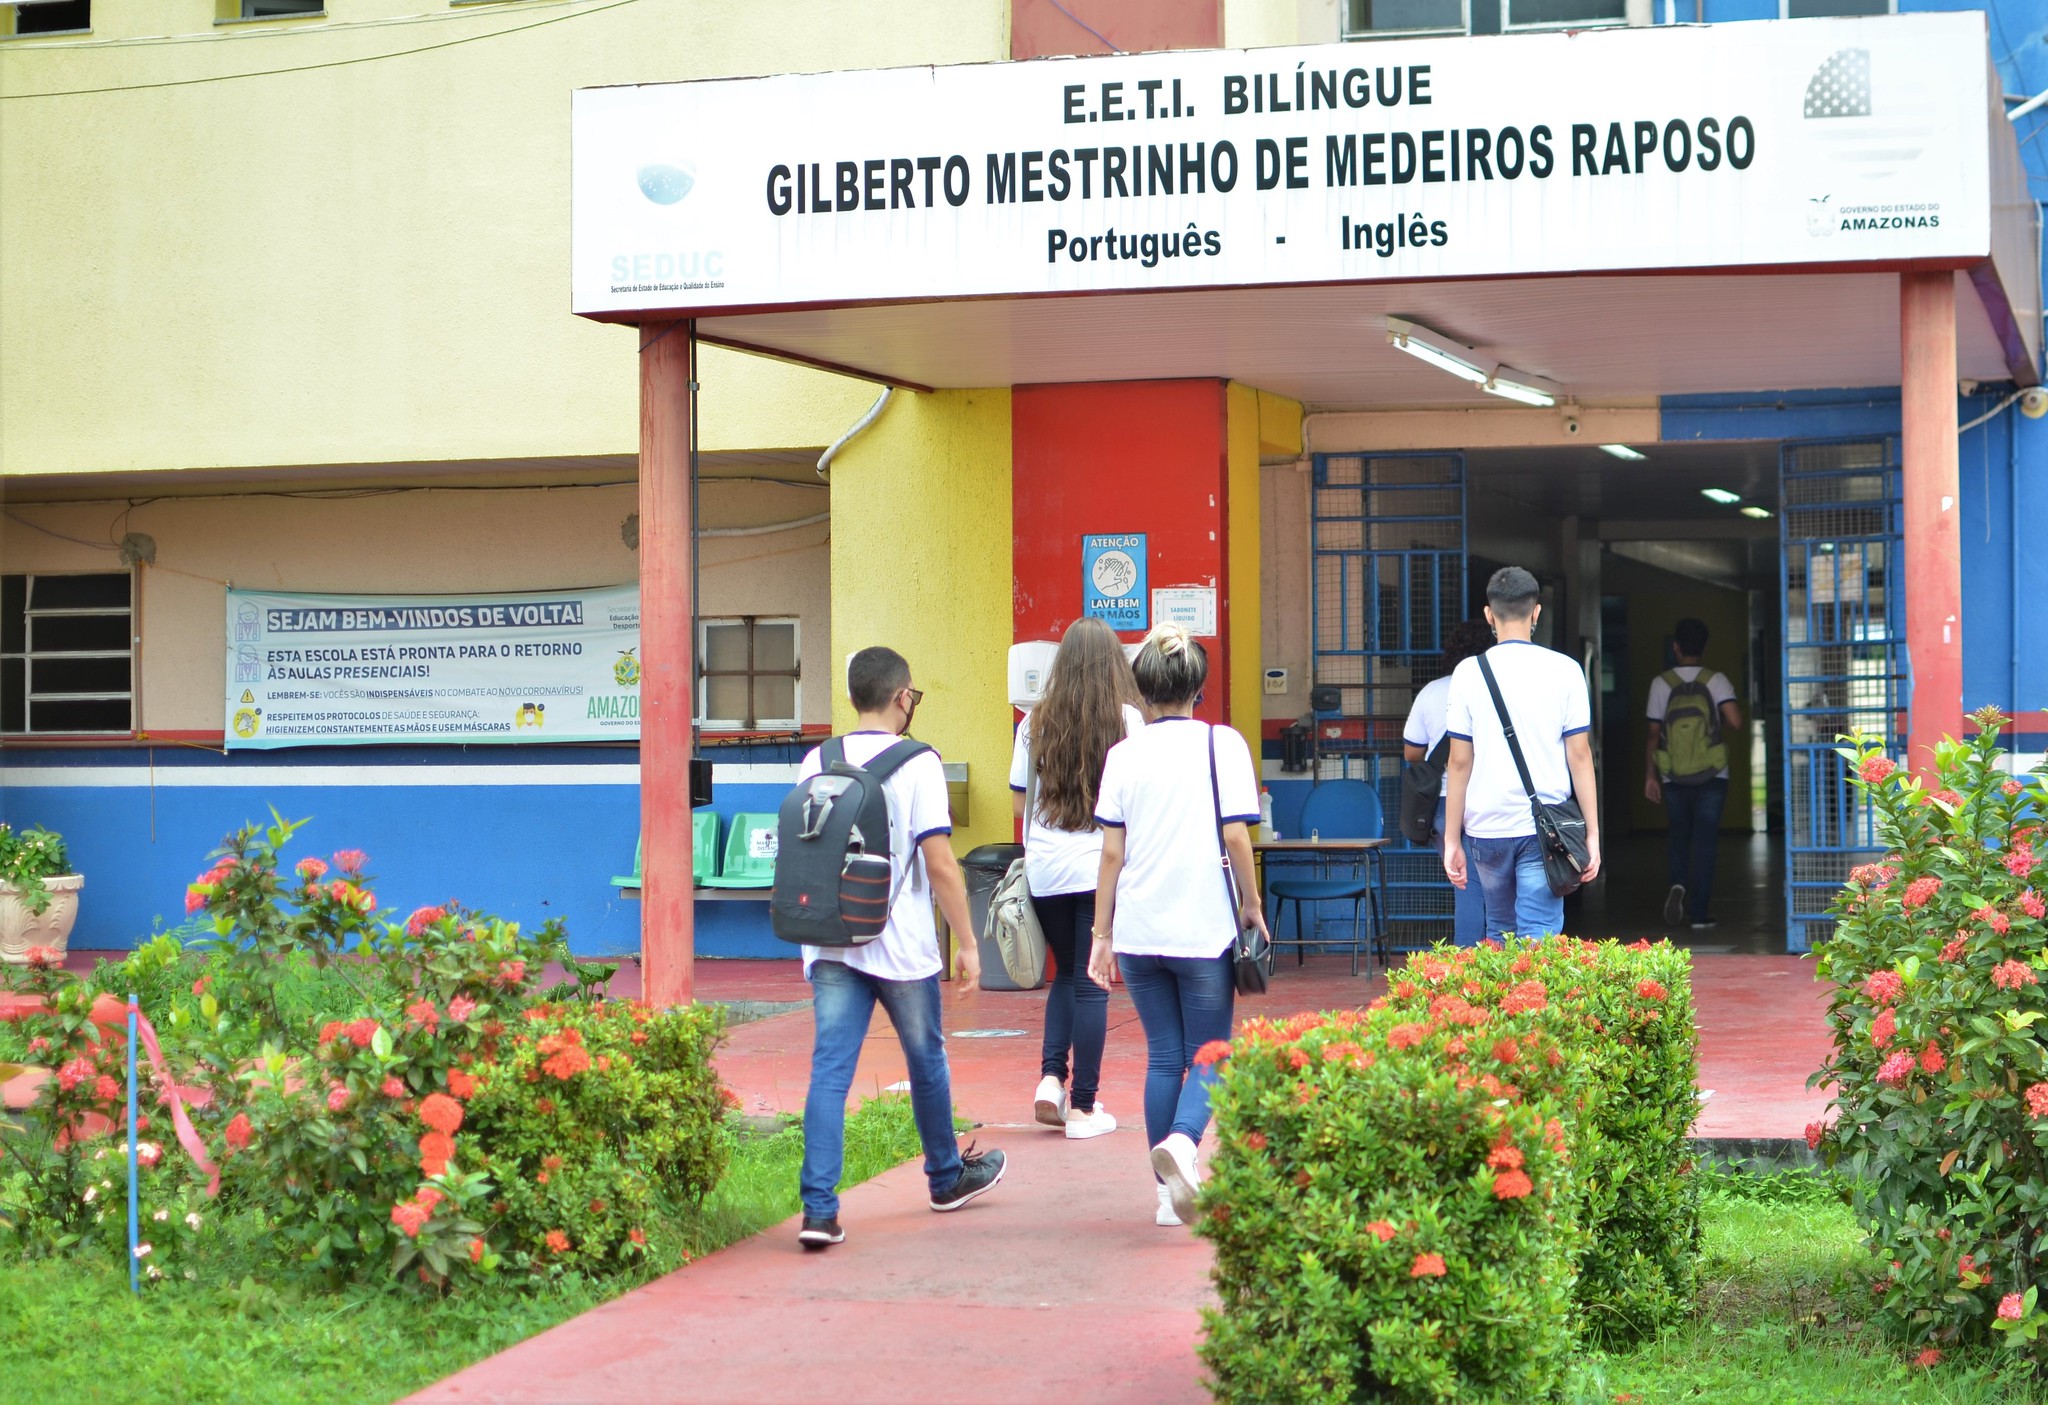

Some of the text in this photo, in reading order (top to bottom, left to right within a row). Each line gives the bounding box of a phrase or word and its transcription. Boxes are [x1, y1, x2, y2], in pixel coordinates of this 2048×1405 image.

[1064, 62, 1431, 123] E.E.T.I. BILÍNGUE
[767, 116, 1754, 215] GILBERTO MESTRINHO DE MEDEIROS RAPOSO
[1840, 203, 1940, 214] GOVERNO DO ESTADO DO
[1840, 216, 1940, 230] AMAZONAS
[1049, 223, 1221, 267] Português
[1343, 213, 1448, 257] Inglês
[610, 250, 724, 282] SEDUC
[611, 285, 632, 293] Secretaria
[639, 284, 652, 292] Estado
[659, 283, 679, 292] Educação
[683, 282, 703, 290] Qualidade
[1091, 536, 1139, 549] ATENÇÃO
[1091, 598, 1139, 608] LAVE BEM
[268, 604, 582, 630] SEJAM BEM-VINDOS DE VOLTA!
[610, 614, 639, 622] Educação
[1108, 608, 1140, 619] MÃOS
[268, 642, 582, 662] ESTA ESCOLA ESTÁ PRONTA PARA O RETORNO
[268, 665, 430, 680] ÀS AULAS PRESENCIAIS!
[268, 685, 583, 700] LEMBREM-SE: VOCÊS SÃO INDISPENSÁVEIS NO COMBATE AO NOVO CORONAVÍRUS!
[587, 696, 640, 718] AMAZO
[267, 712, 313, 721] RESPEITEM
[327, 712, 380, 720] PROTOCOLOS
[394, 710, 421, 719] SAÚDE
[428, 710, 479, 719] SEGURANÇA:
[266, 726, 314, 734] HIGIENIZEM
[316, 724, 393, 733] CONSTANTEMENTE
[406, 723, 431, 732] MÃOS
[464, 722, 510, 731] MÁSCARAS
